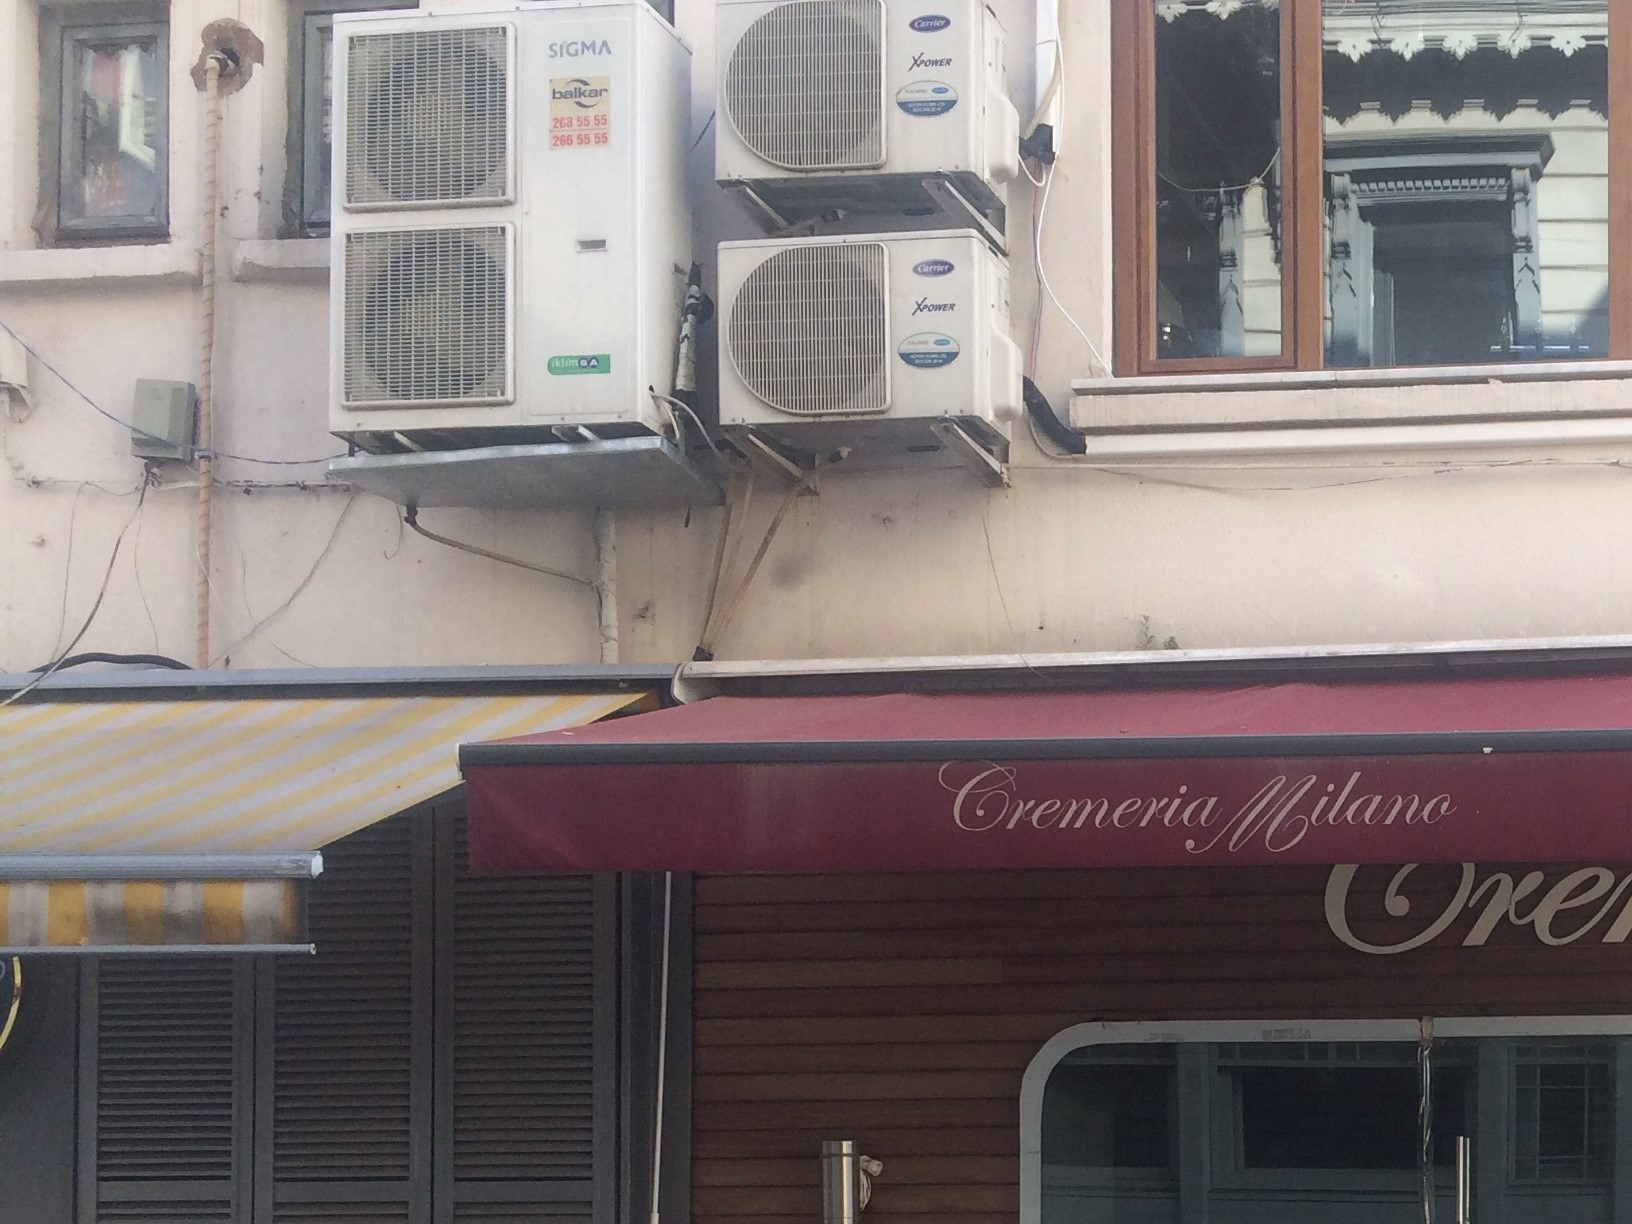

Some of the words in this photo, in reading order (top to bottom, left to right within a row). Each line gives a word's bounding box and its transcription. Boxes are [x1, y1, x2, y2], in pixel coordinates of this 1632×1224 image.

[913, 18, 947, 29] Carrier
[548, 39, 613, 59] SIGMA
[908, 51, 953, 72] XPOWER
[551, 87, 609, 100] balkar
[576, 115, 591, 128] 55
[593, 114, 608, 127] 55
[552, 134, 574, 147] 266
[576, 133, 591, 146] 55
[594, 132, 609, 145] 55
[917, 264, 950, 273] Carrier
[911, 296, 956, 316] XPOWER
[938, 759, 1223, 832] Cremeria
[1185, 770, 1458, 854] Milano
